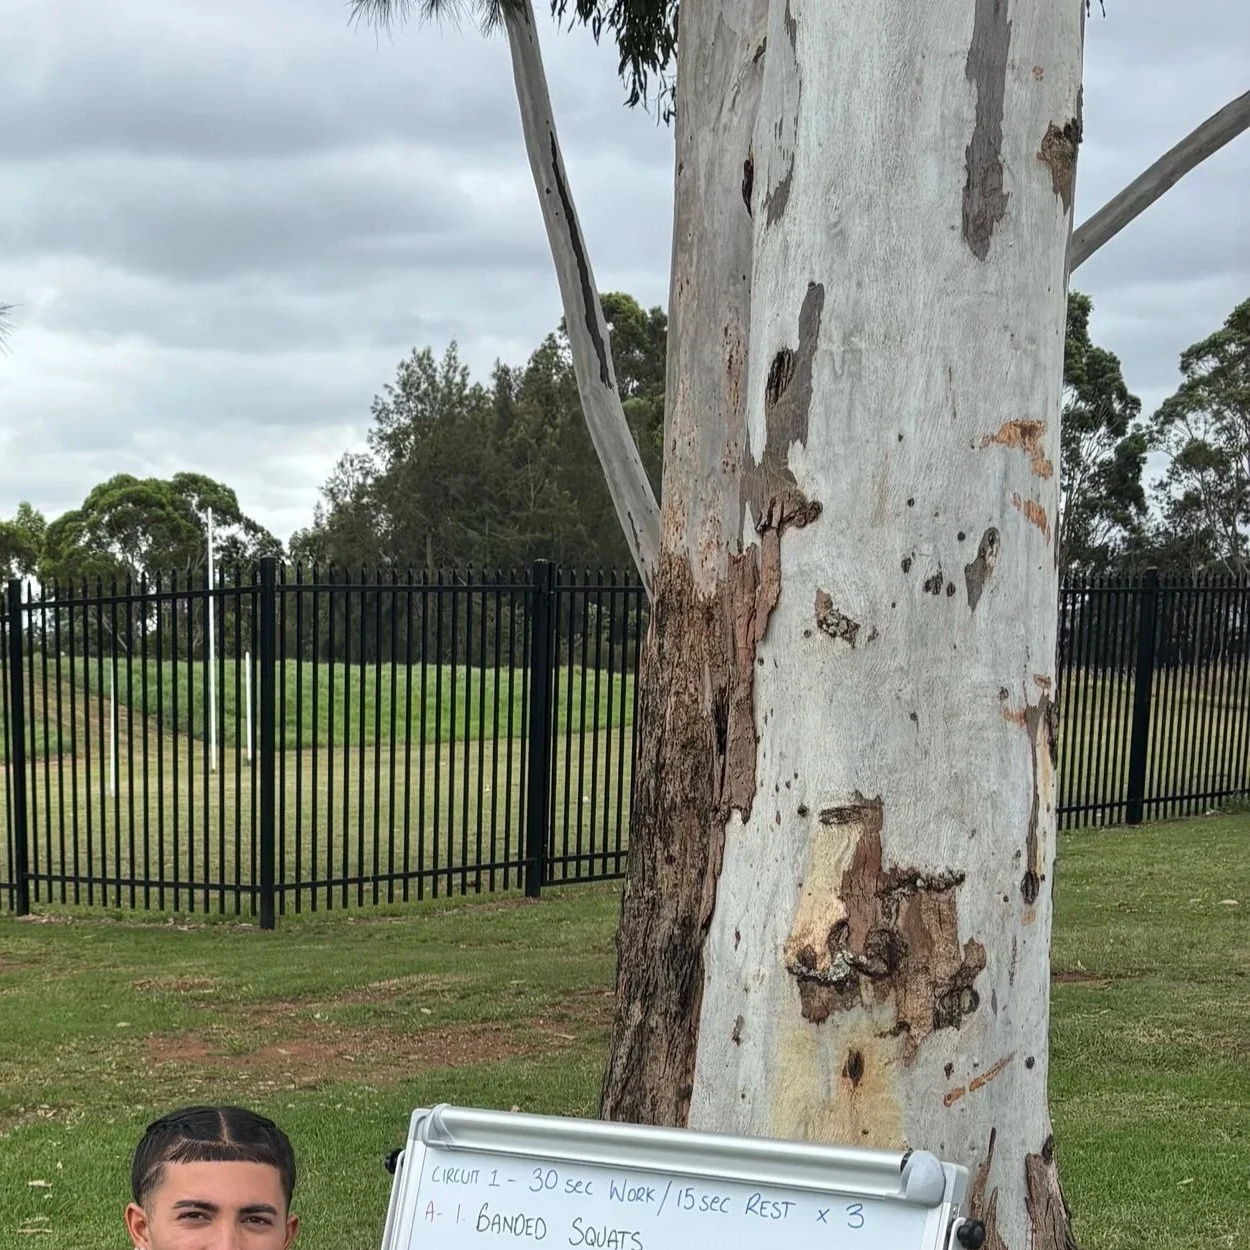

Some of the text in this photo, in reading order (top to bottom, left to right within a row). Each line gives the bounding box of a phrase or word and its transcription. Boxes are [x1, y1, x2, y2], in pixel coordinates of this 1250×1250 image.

[431, 1165, 481, 1185] CIRCUIT
[745, 1192, 797, 1220] REST
[846, 1202, 865, 1229] 3
[476, 1202, 547, 1241] BANDED
